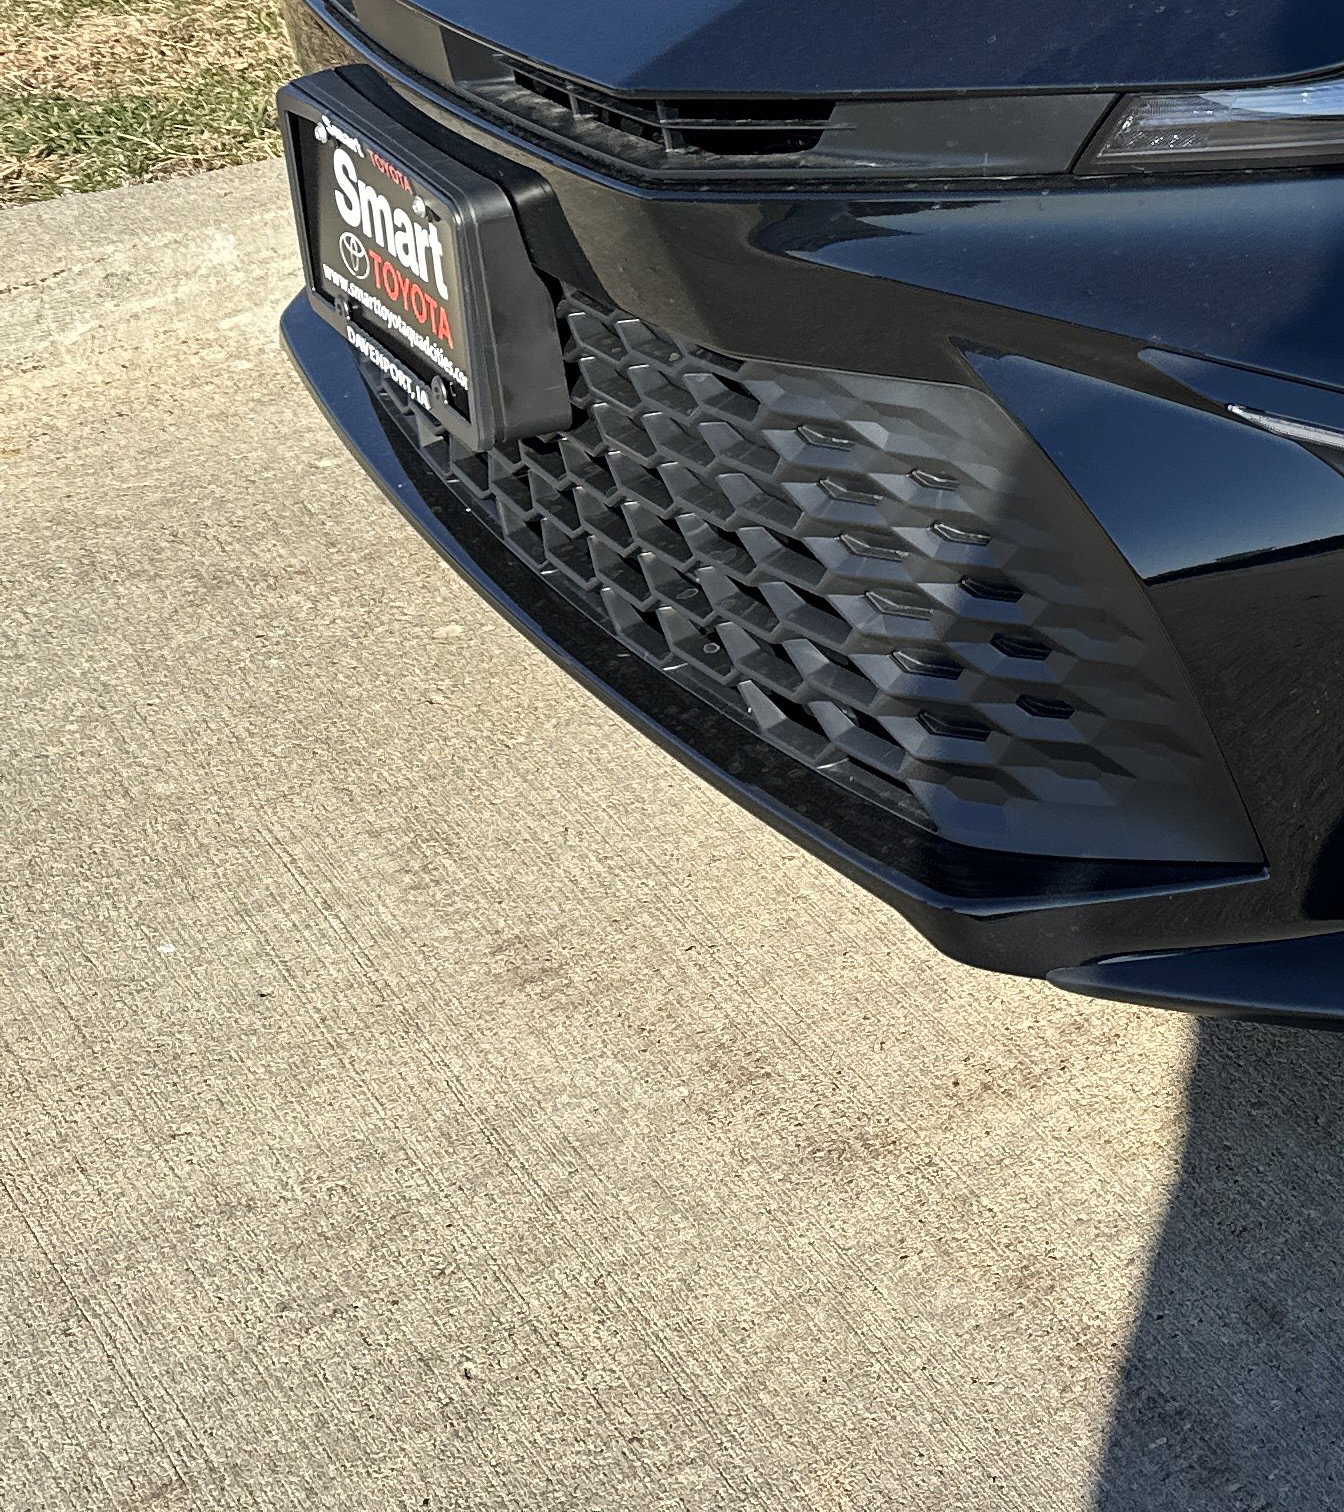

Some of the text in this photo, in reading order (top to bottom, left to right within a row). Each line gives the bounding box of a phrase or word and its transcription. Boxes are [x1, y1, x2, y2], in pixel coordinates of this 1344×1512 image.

[322, 115, 413, 195] Smart TOYOTA
[333, 148, 449, 300] Smart
[369, 249, 454, 350] TOYOTA
[416, 386, 431, 410] IA
